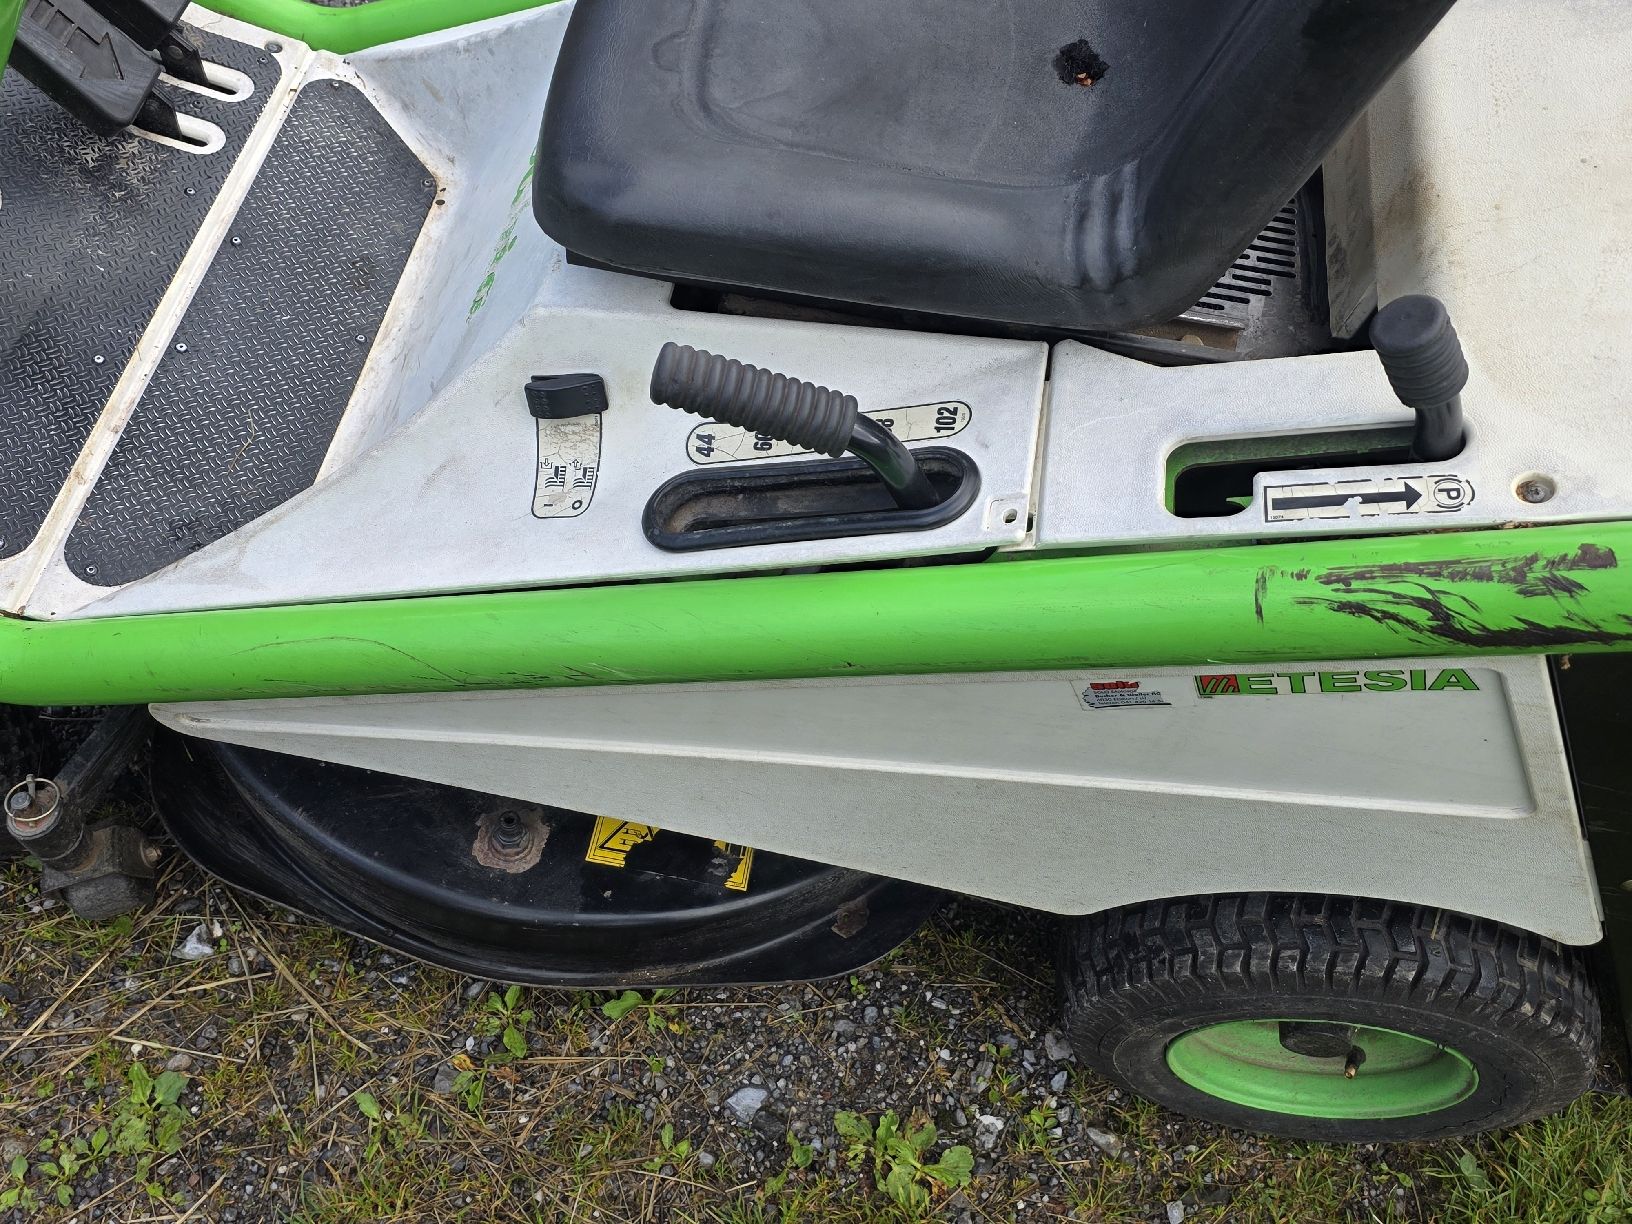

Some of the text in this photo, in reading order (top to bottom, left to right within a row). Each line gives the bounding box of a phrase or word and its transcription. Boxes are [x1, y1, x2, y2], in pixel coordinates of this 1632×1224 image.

[934, 406, 959, 433] 102
[695, 433, 716, 458] 44
[1438, 487, 1461, 501] P
[1238, 667, 1480, 695] ETESIA
